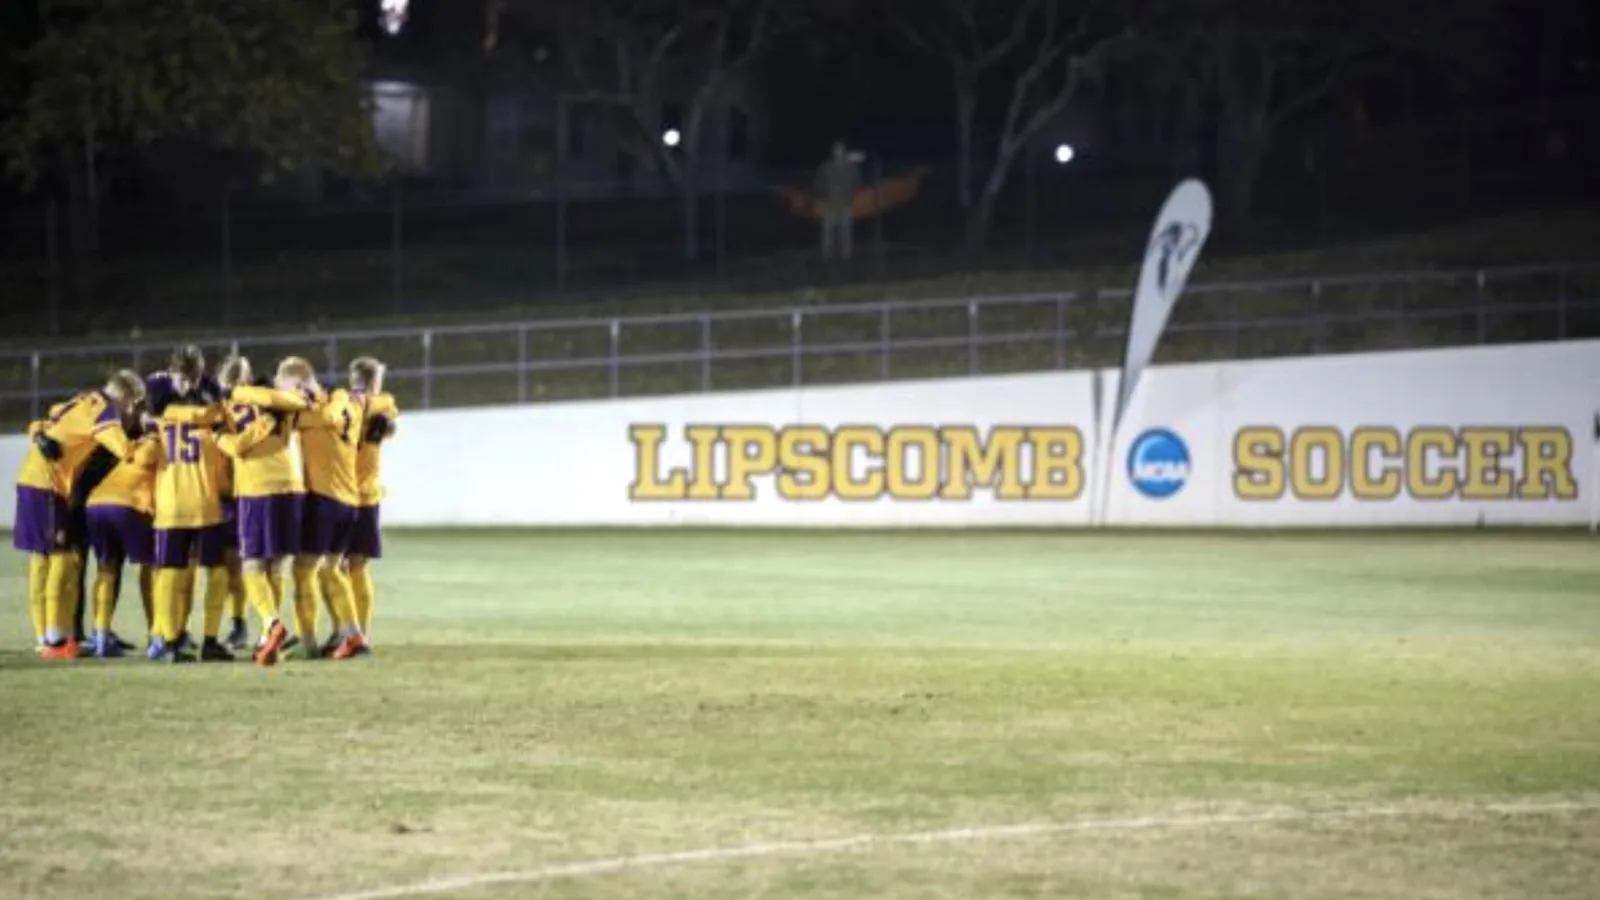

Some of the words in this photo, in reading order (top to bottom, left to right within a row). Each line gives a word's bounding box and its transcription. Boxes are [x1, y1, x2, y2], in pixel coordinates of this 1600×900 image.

[164, 423, 200, 463] 15
[628, 424, 1084, 500] LIPSCOMB
[1233, 426, 1577, 500] SOCCER
